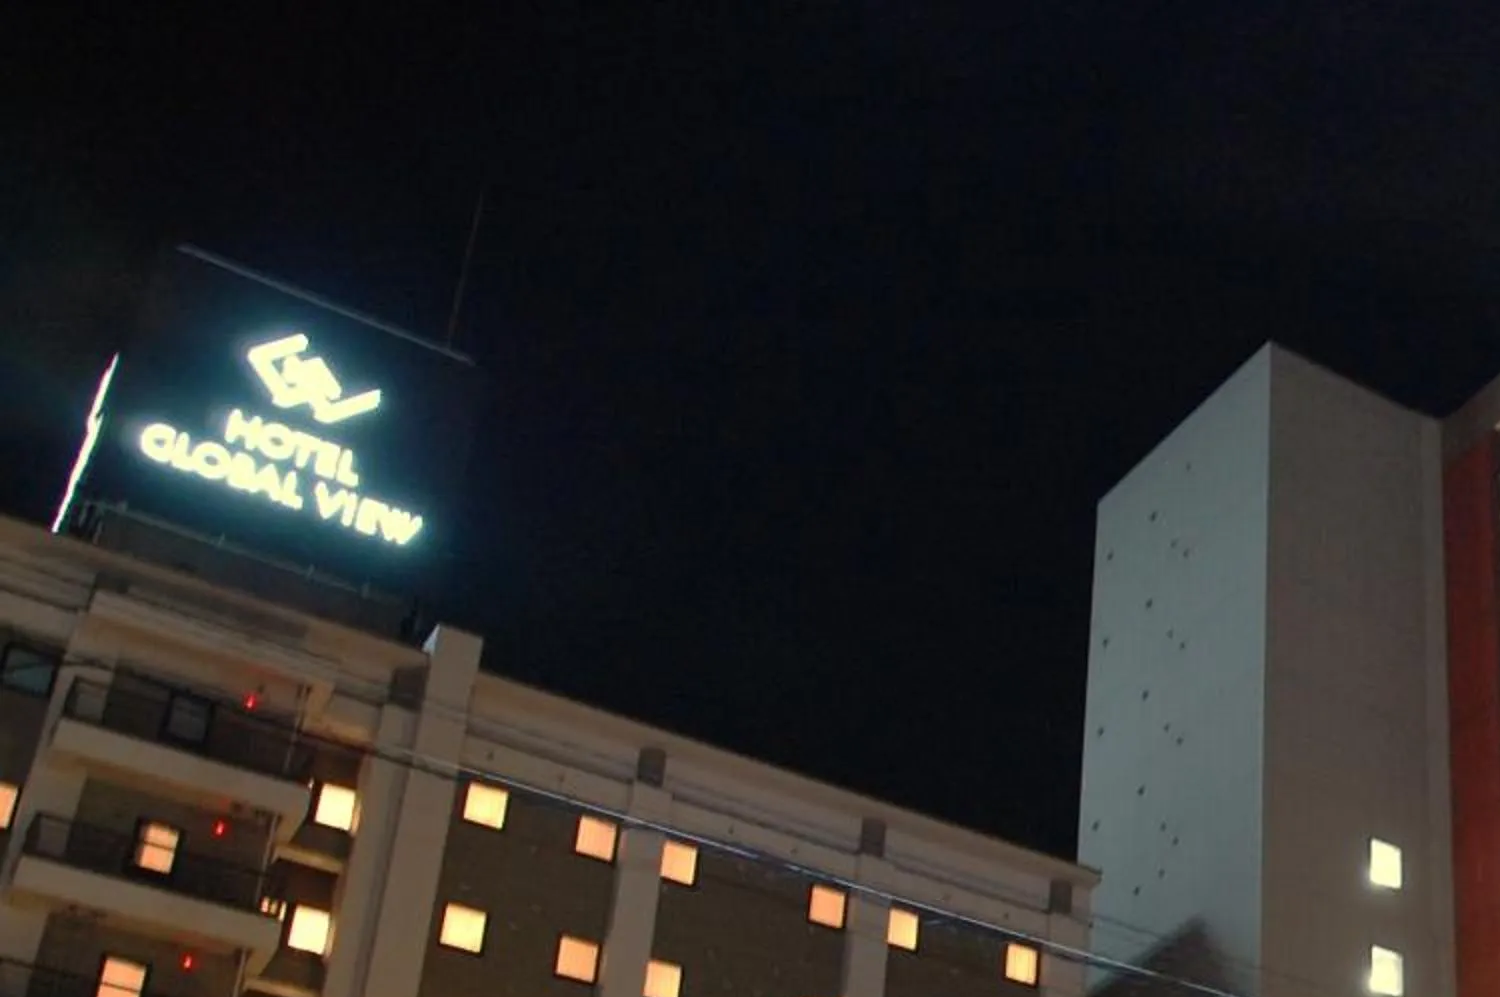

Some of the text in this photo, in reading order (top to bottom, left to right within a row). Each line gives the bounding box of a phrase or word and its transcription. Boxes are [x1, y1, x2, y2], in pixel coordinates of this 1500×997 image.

[139, 423, 423, 545] GLOBAL VIEW
[224, 408, 359, 487] HOTEL
